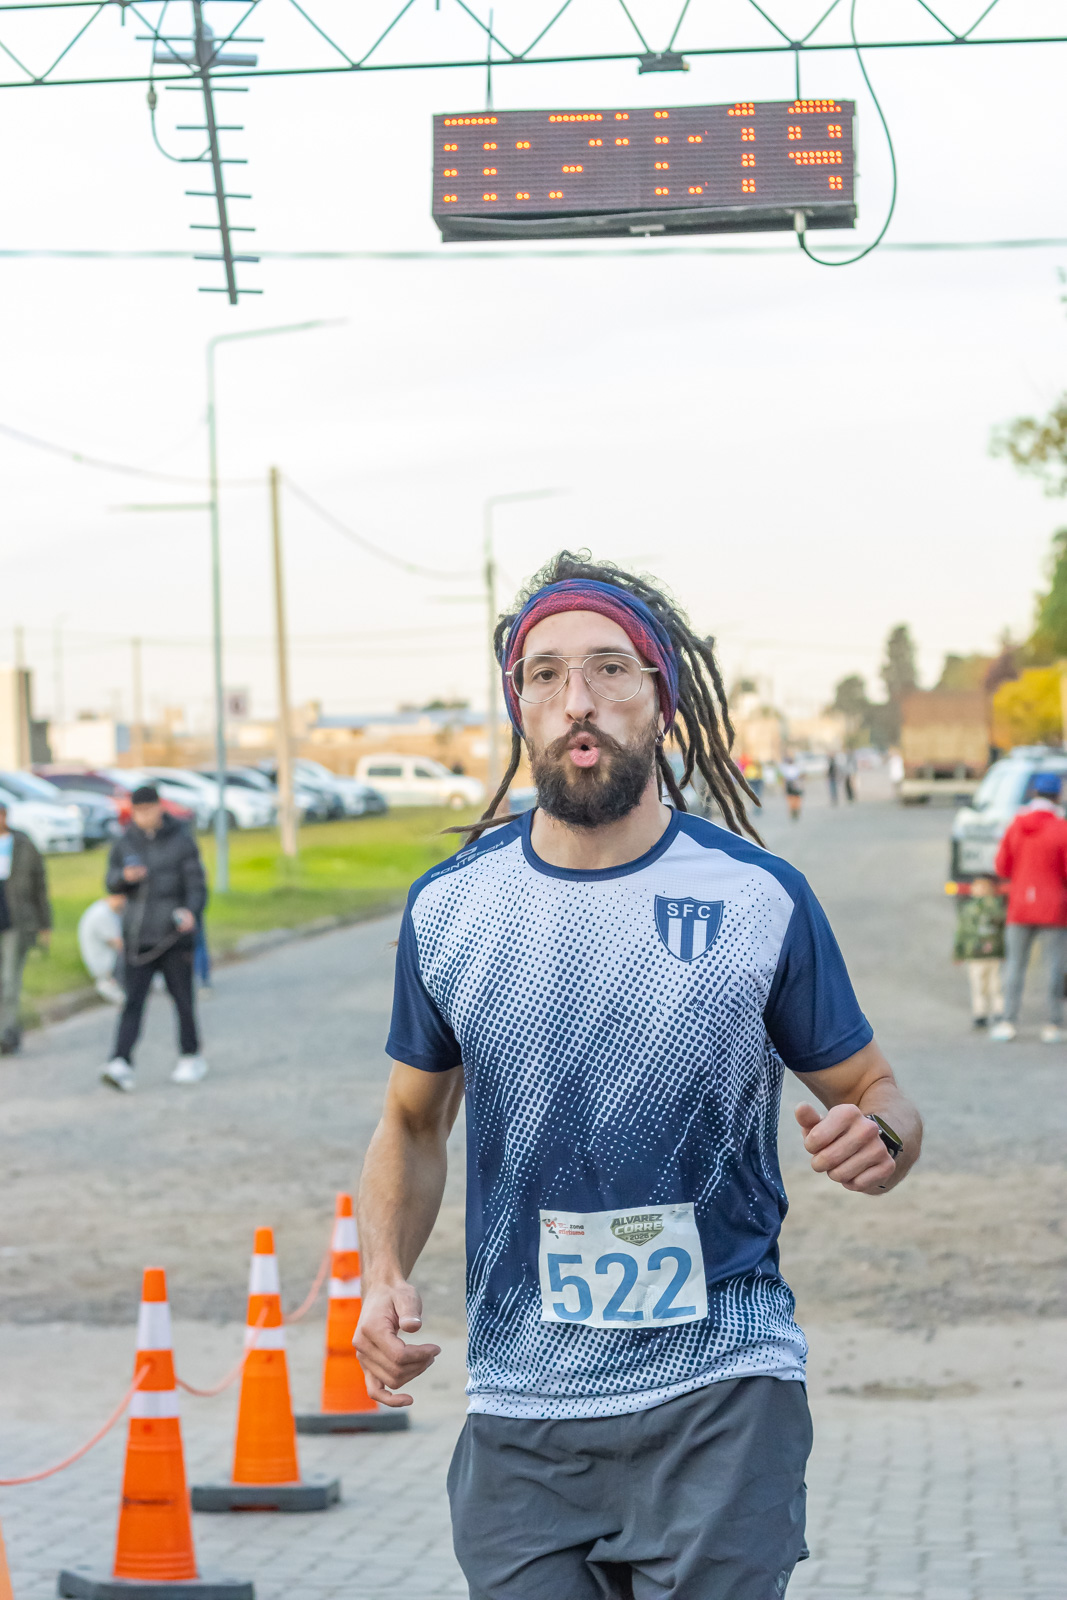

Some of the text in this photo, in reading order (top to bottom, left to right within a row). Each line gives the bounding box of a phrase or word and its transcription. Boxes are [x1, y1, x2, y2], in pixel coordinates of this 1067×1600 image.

[666, 902, 711, 919] SFC
[612, 1213, 664, 1227] ALVAREZ
[614, 1222, 663, 1236] CORRE
[547, 1246, 697, 1322] 522
